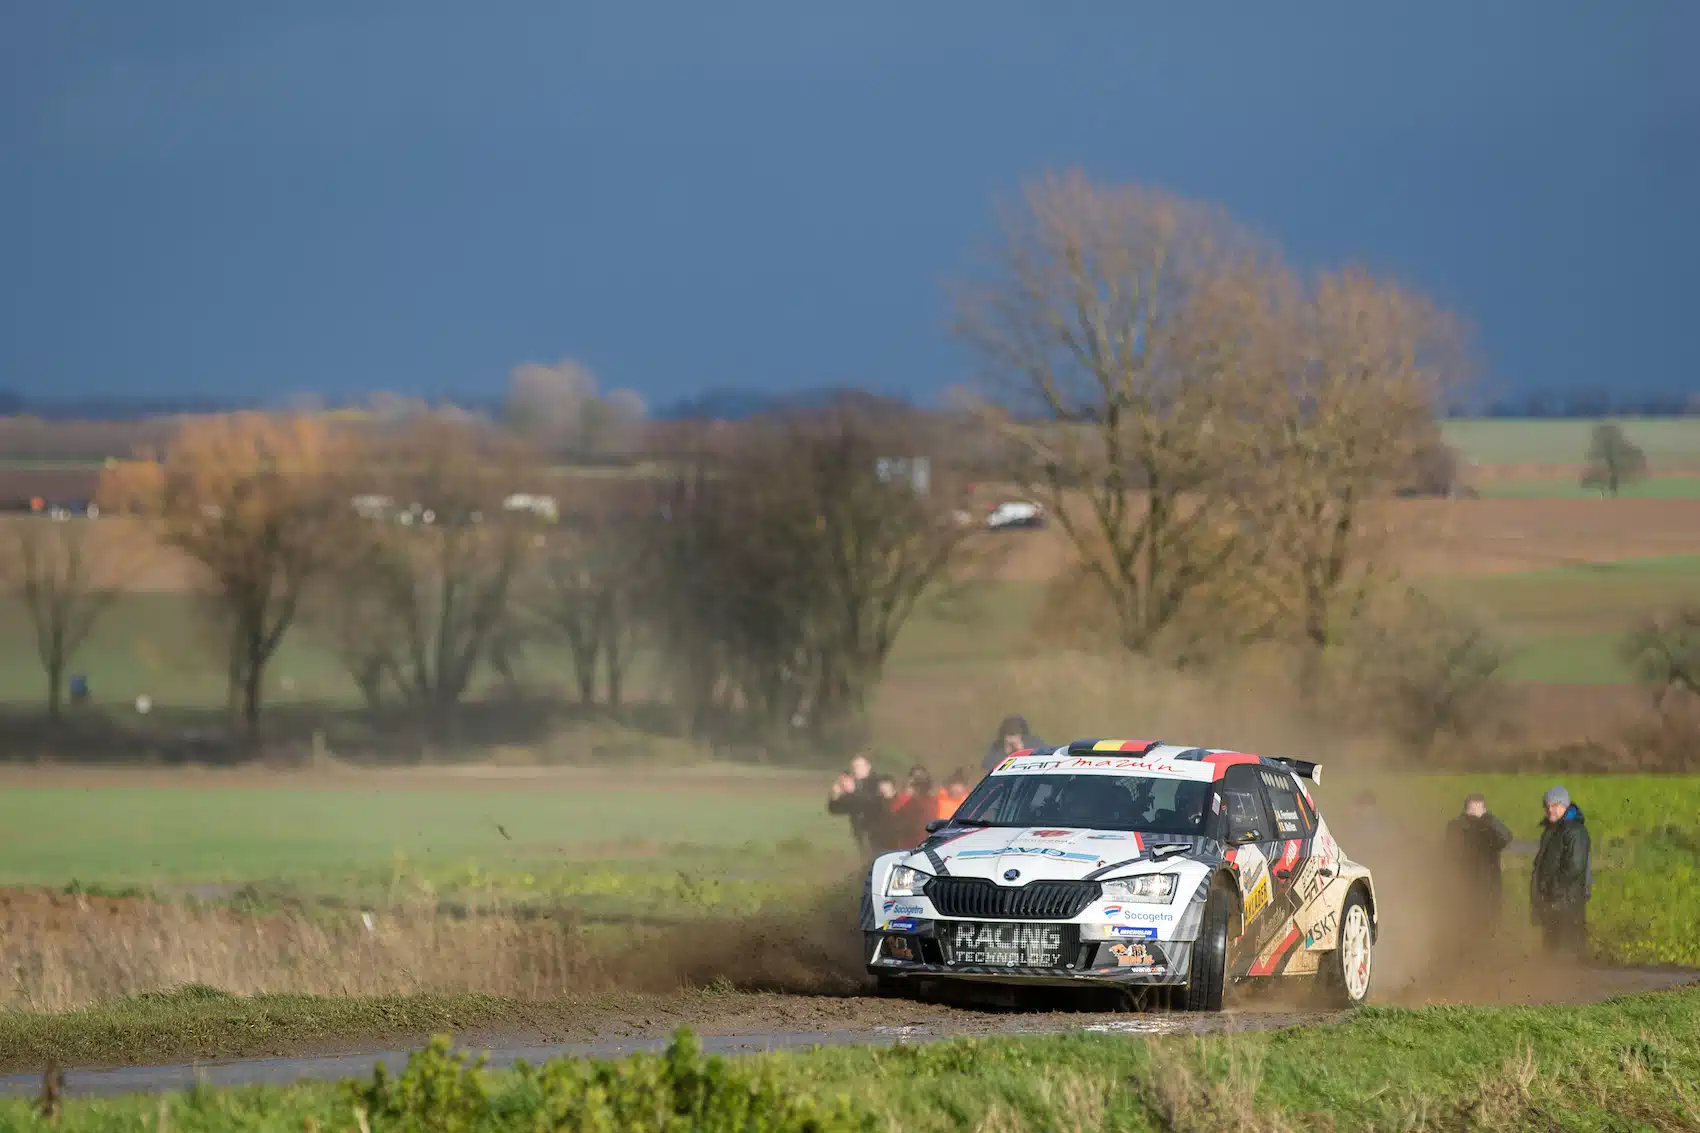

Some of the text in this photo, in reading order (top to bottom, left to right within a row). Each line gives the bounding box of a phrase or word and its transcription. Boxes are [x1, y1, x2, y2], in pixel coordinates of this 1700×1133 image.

[893, 904, 924, 915] Socogetra
[1124, 910, 1174, 922] Socogetra
[1313, 910, 1338, 941] SKT
[954, 923, 1061, 949] RACING
[955, 951, 1061, 966] TECHNOLOGY
